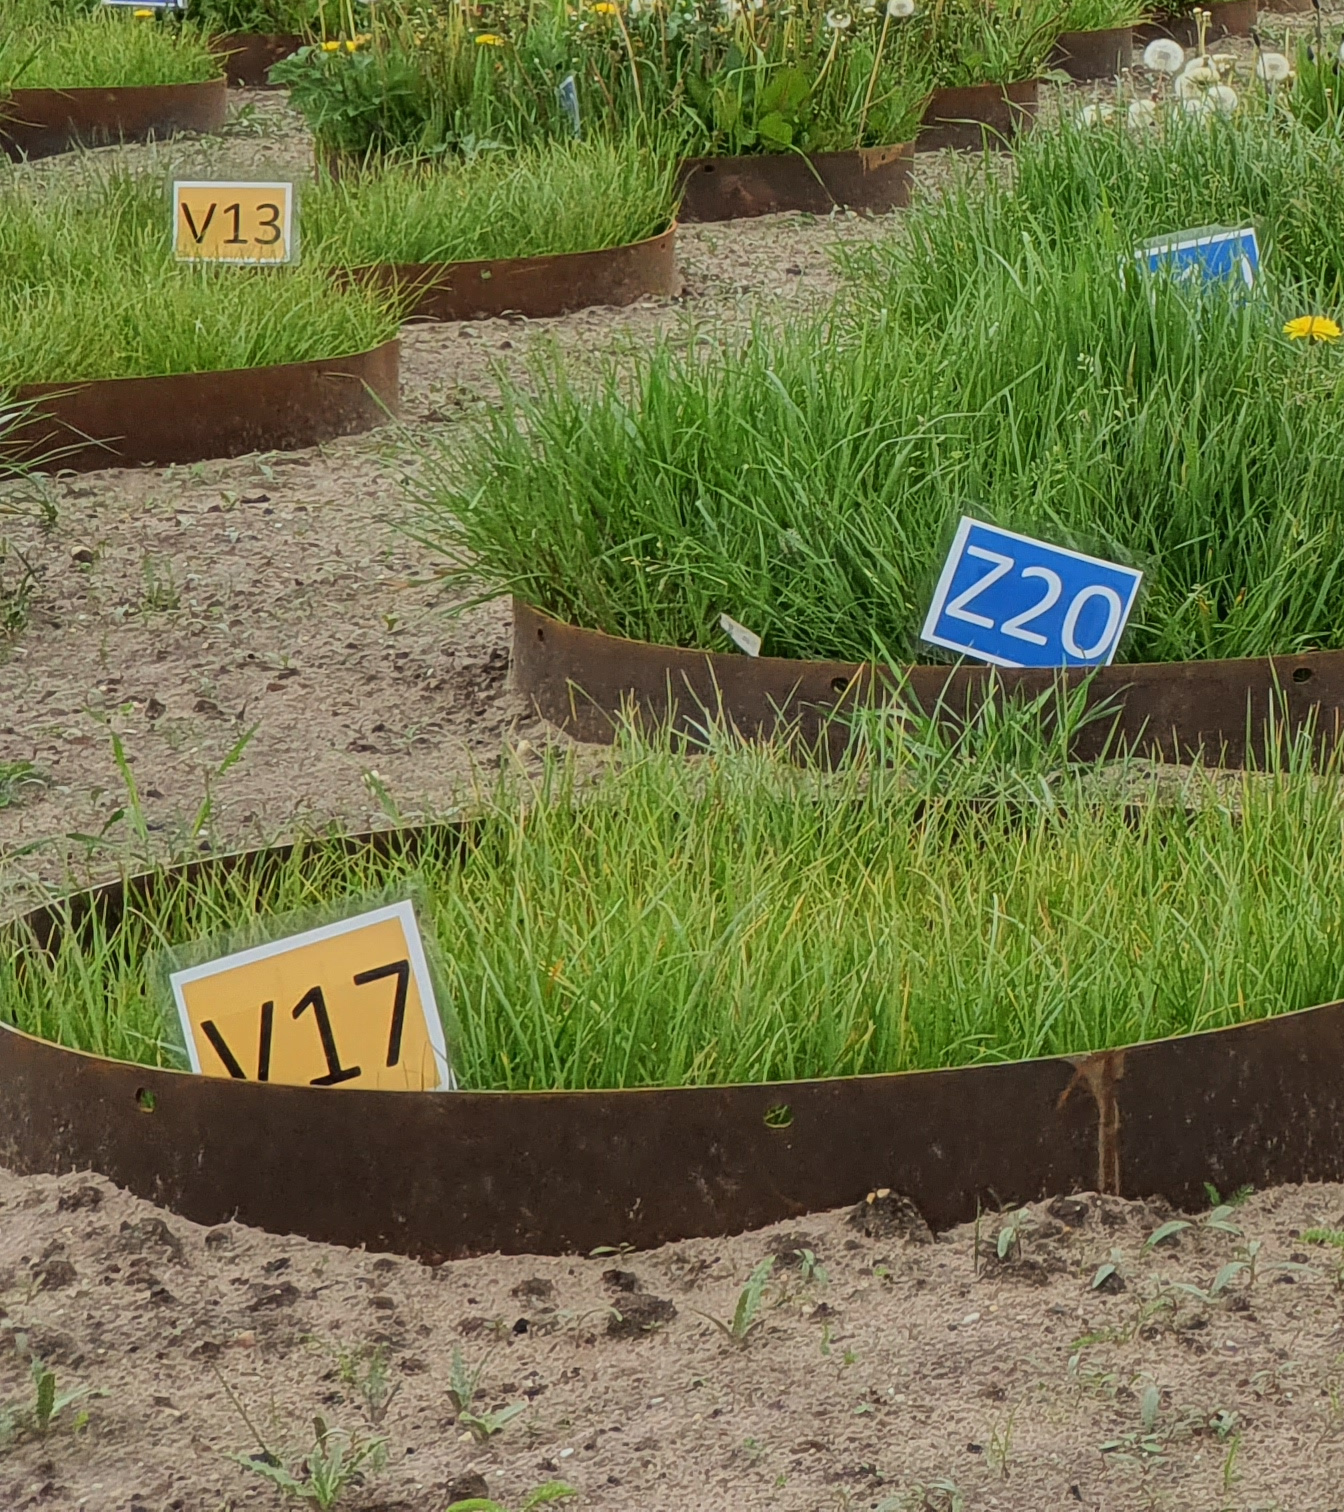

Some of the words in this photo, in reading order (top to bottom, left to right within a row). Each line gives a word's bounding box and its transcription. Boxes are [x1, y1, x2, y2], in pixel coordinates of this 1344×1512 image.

[180, 202, 282, 246] V13
[944, 544, 1122, 660] Z20
[200, 958, 410, 1087] V17
